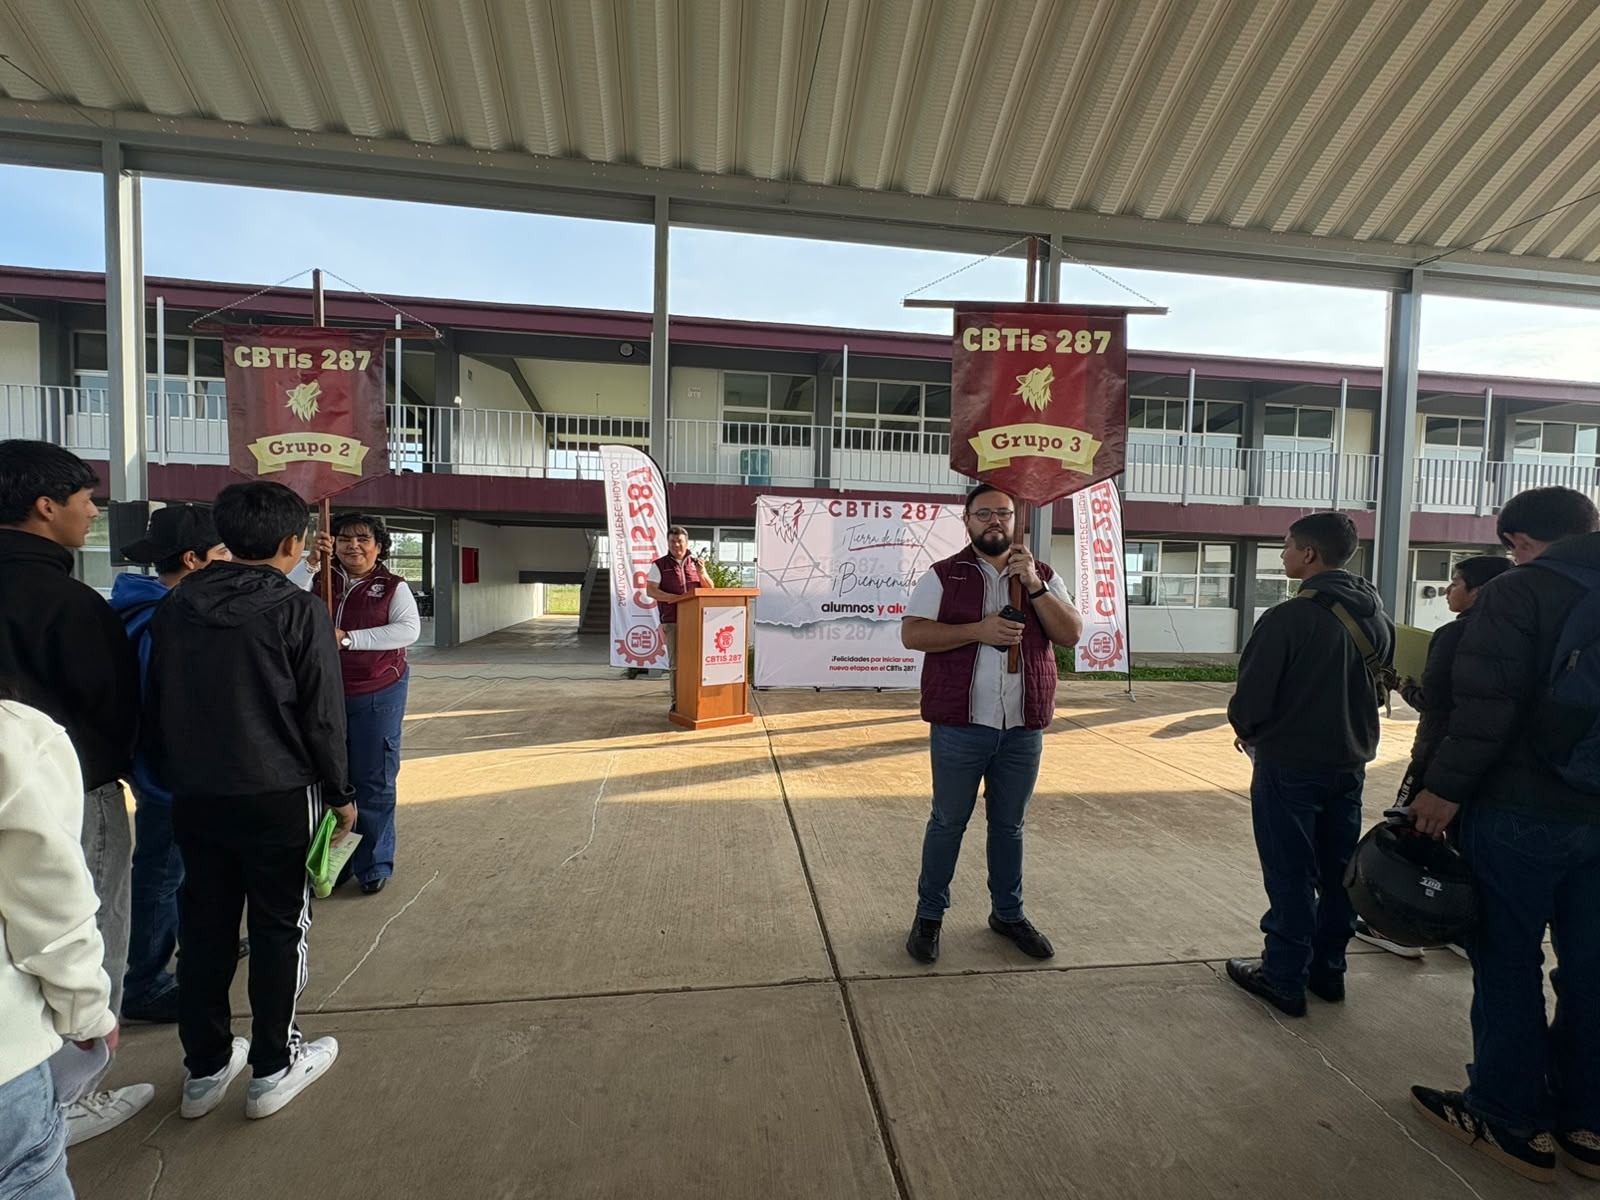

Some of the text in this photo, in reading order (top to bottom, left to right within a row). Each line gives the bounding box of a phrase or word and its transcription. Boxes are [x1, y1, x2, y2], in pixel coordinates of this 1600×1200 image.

[962, 327, 1112, 354] CBTis 287
[233, 345, 371, 371] CBTis 287
[268, 440, 350, 457] Grupo 2
[991, 432, 1082, 453] Grupo 3
[828, 500, 942, 521] CBTis 287
[881, 529, 892, 545] de
[831, 561, 917, 598] ¡Bienvenido
[821, 601, 875, 613] alumnos
[877, 604, 885, 616] y
[705, 654, 742, 663] CBTIS 287
